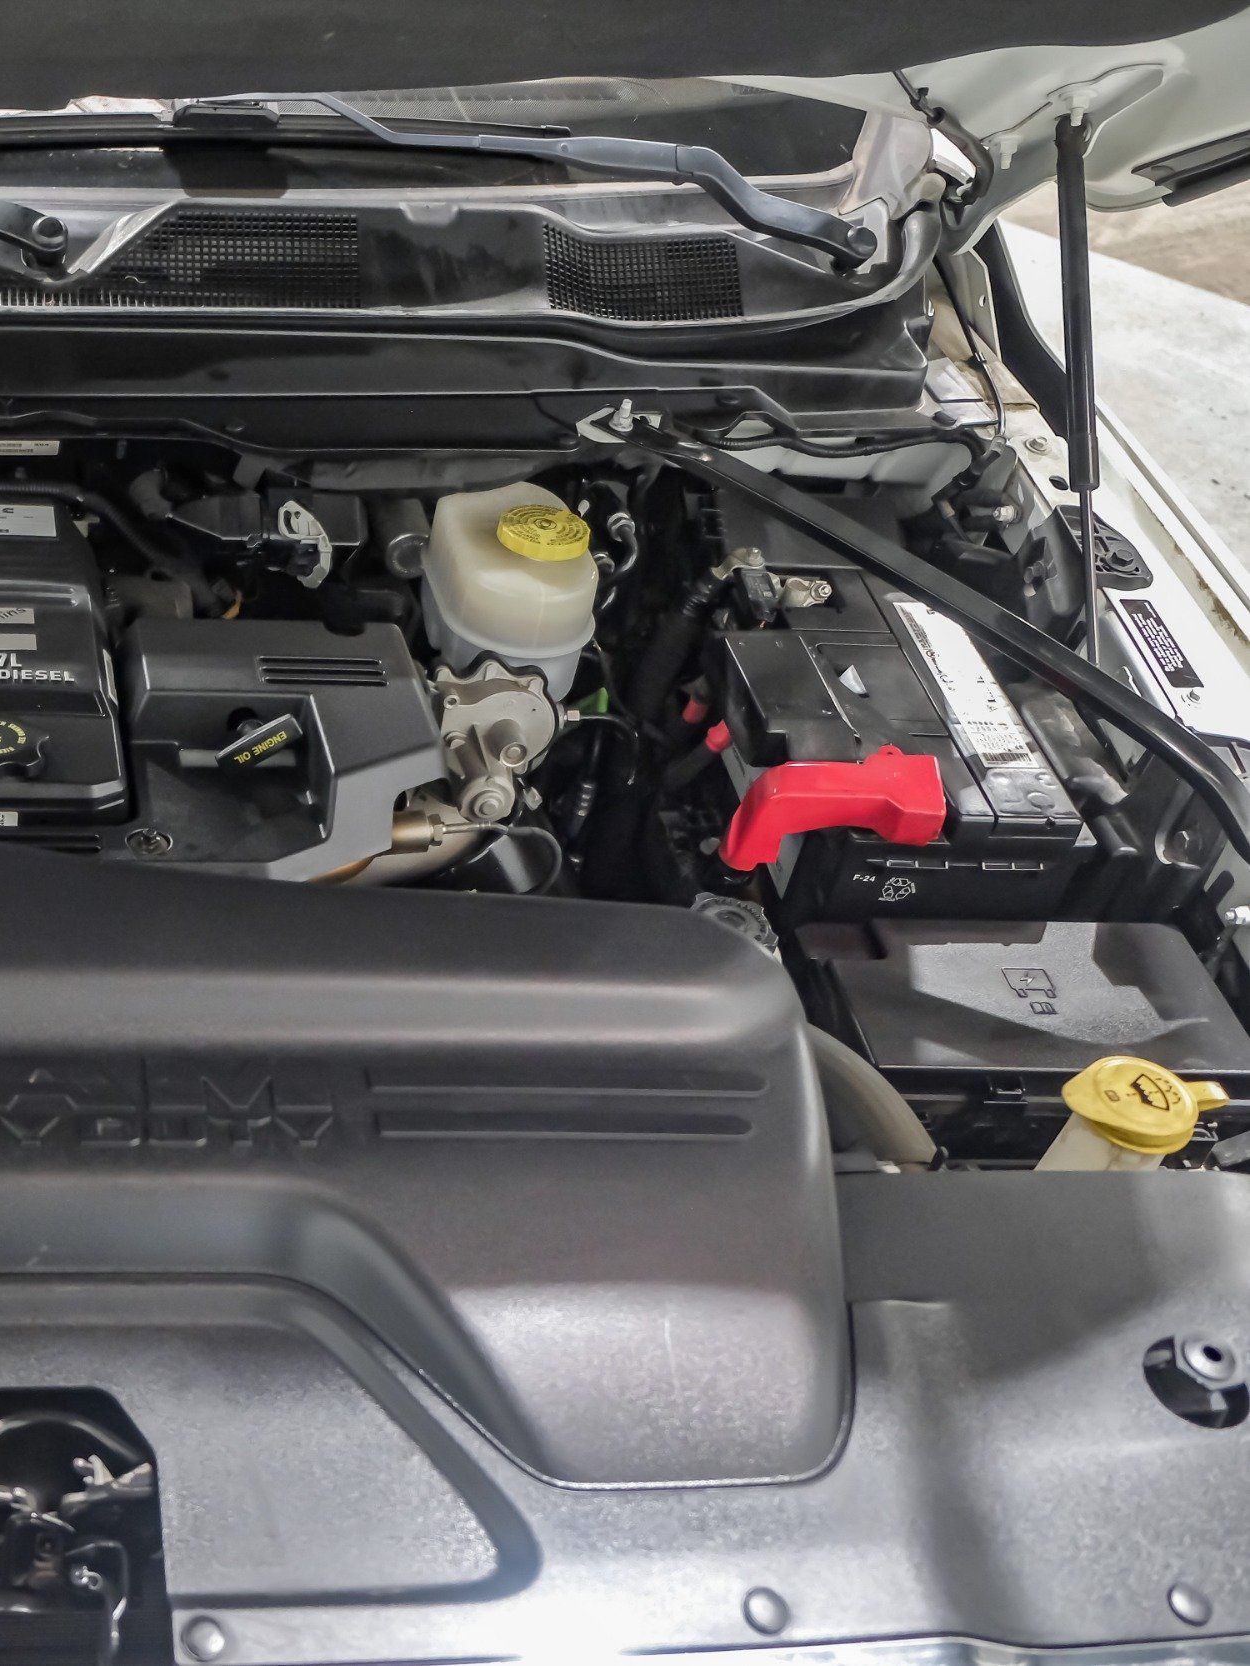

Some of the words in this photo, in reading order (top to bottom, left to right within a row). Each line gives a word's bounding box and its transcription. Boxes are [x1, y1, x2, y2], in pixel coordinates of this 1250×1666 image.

[251, 731, 288, 756] ENGINE
[233, 751, 252, 764] OIL
[852, 874, 876, 882] F-24
[80, 1112, 336, 1148] DUTY
